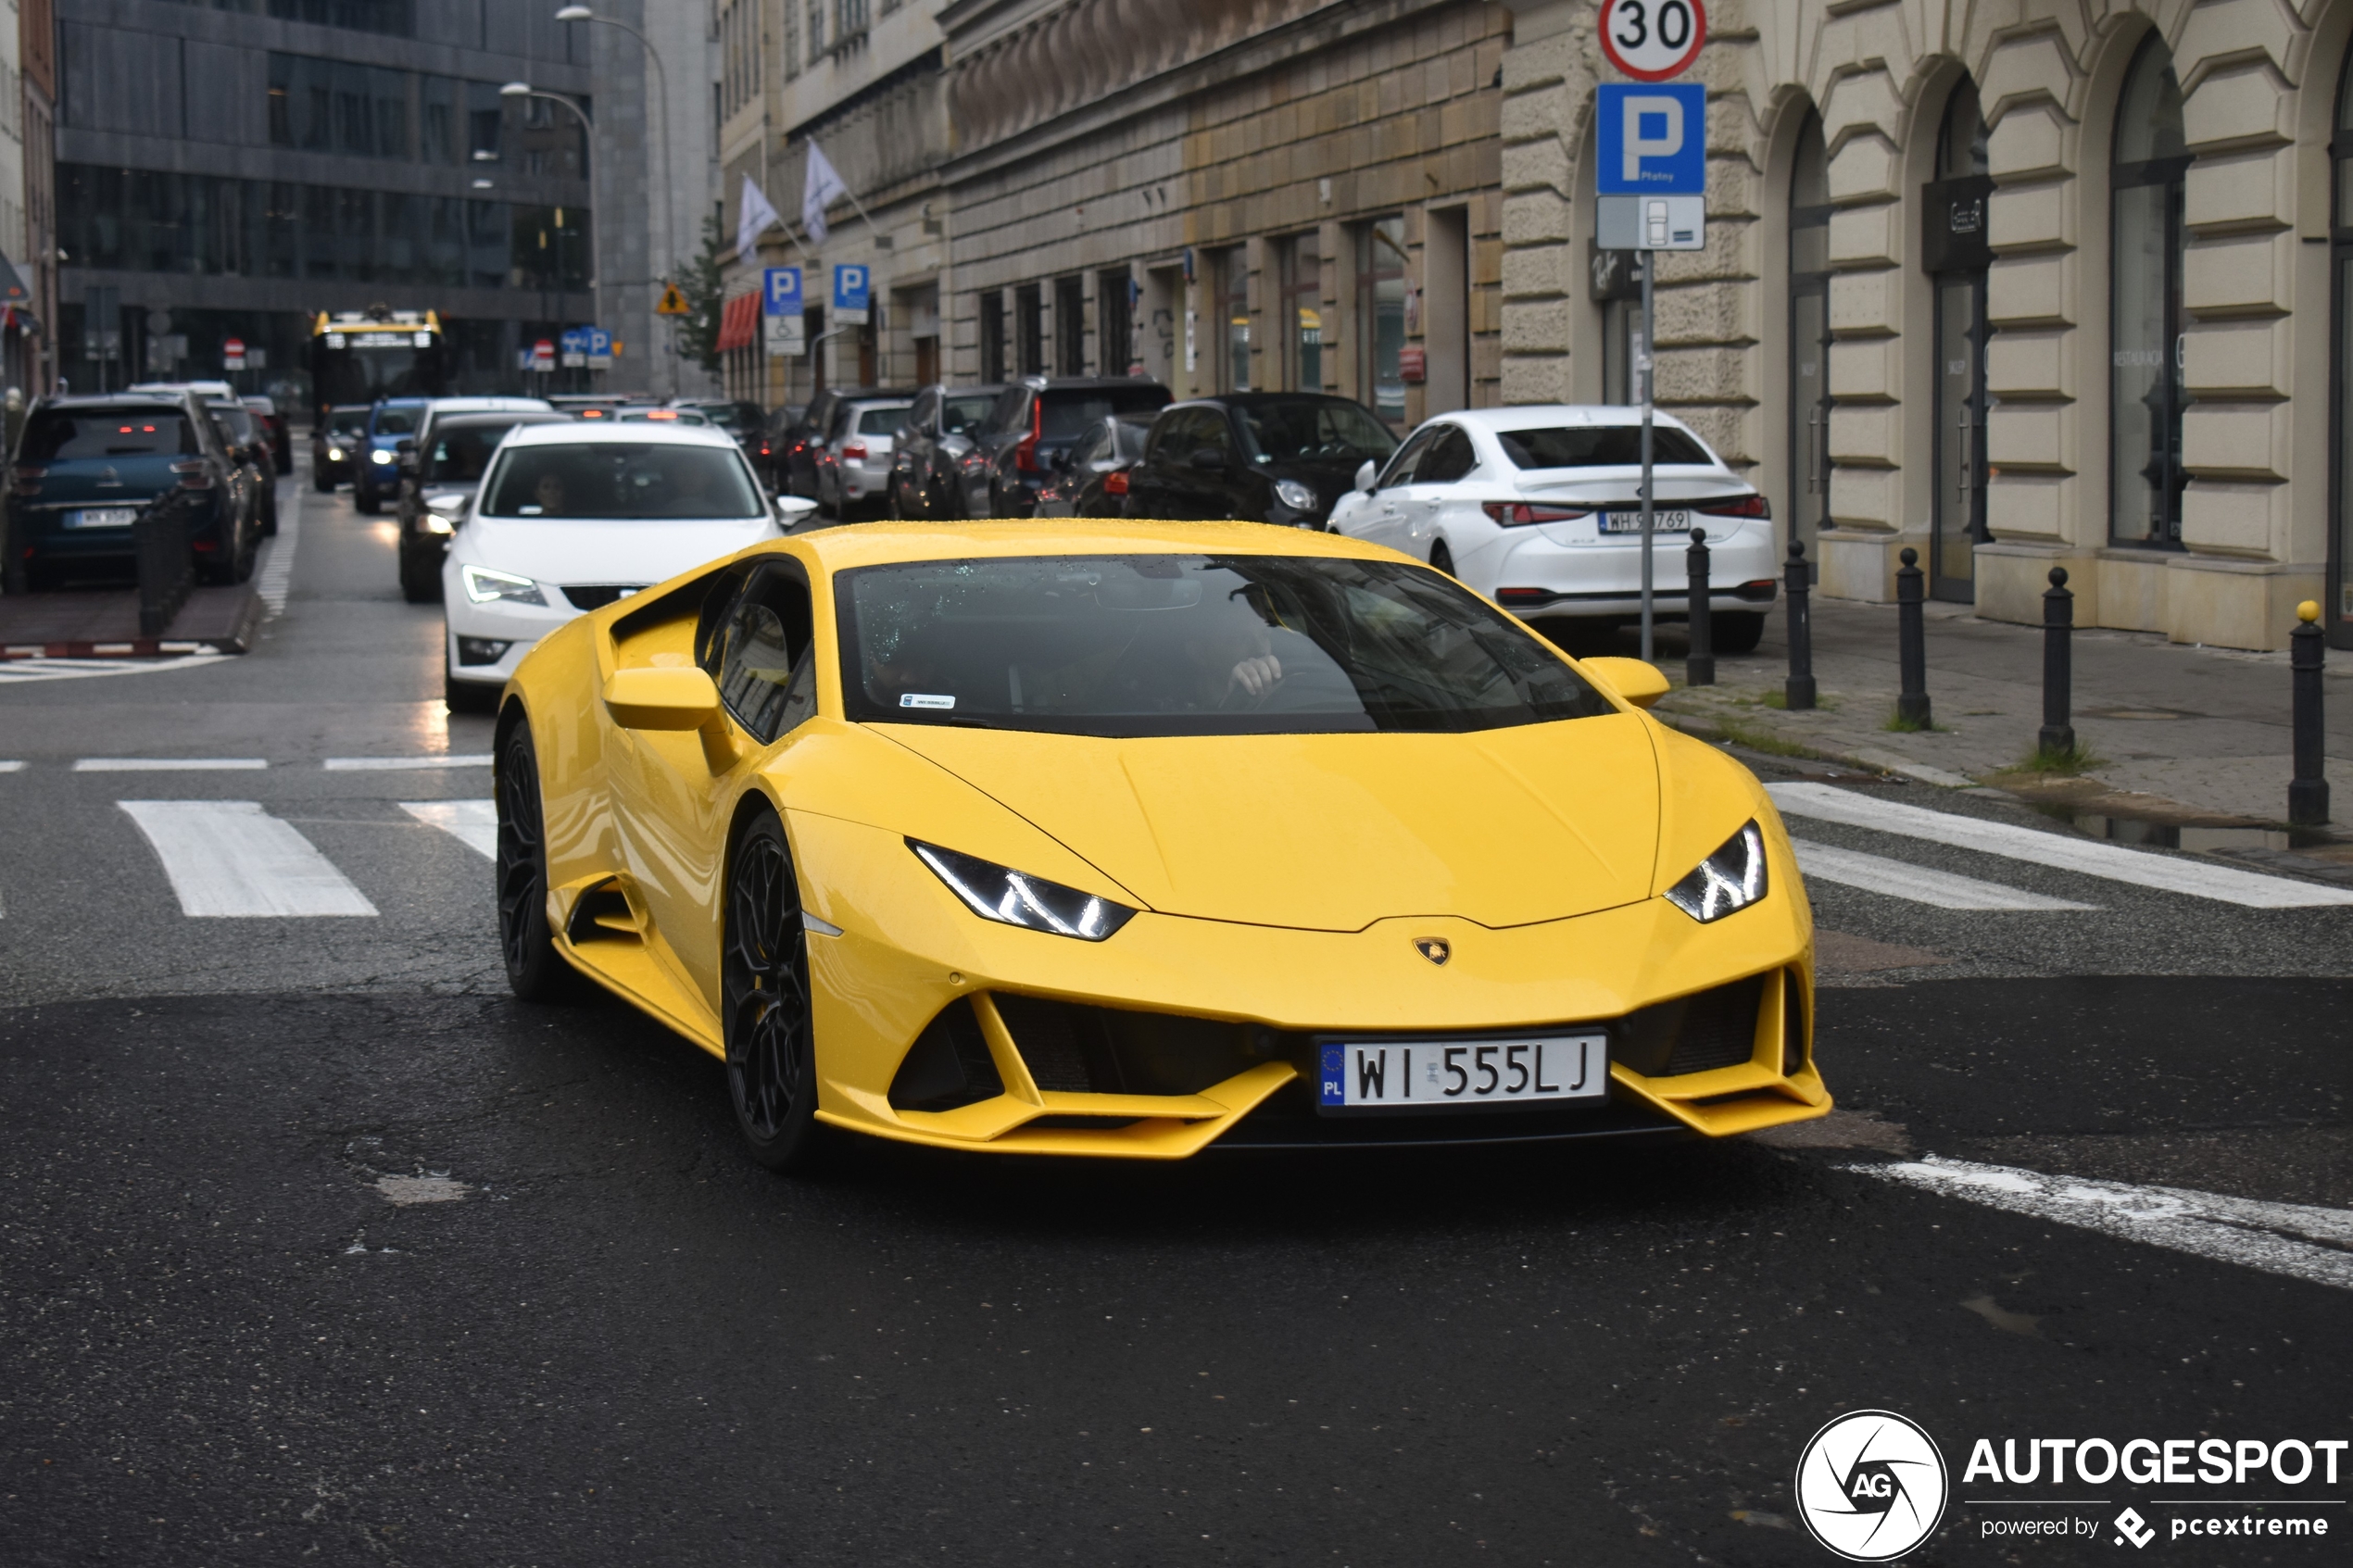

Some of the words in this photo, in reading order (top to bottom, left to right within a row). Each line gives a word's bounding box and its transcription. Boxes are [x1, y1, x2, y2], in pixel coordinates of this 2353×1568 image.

[1617, 1, 1690, 49] 30
[1622, 96, 1683, 181] P
[772, 271, 795, 303] P
[841, 269, 862, 296] P
[591, 333, 608, 353] P
[1610, 514, 1630, 530] WH
[1637, 512, 1685, 528] 9769
[1356, 1047, 1412, 1099] WI
[1442, 1041, 1588, 1097] 555LJ
[1324, 1081, 1342, 1096] PL
